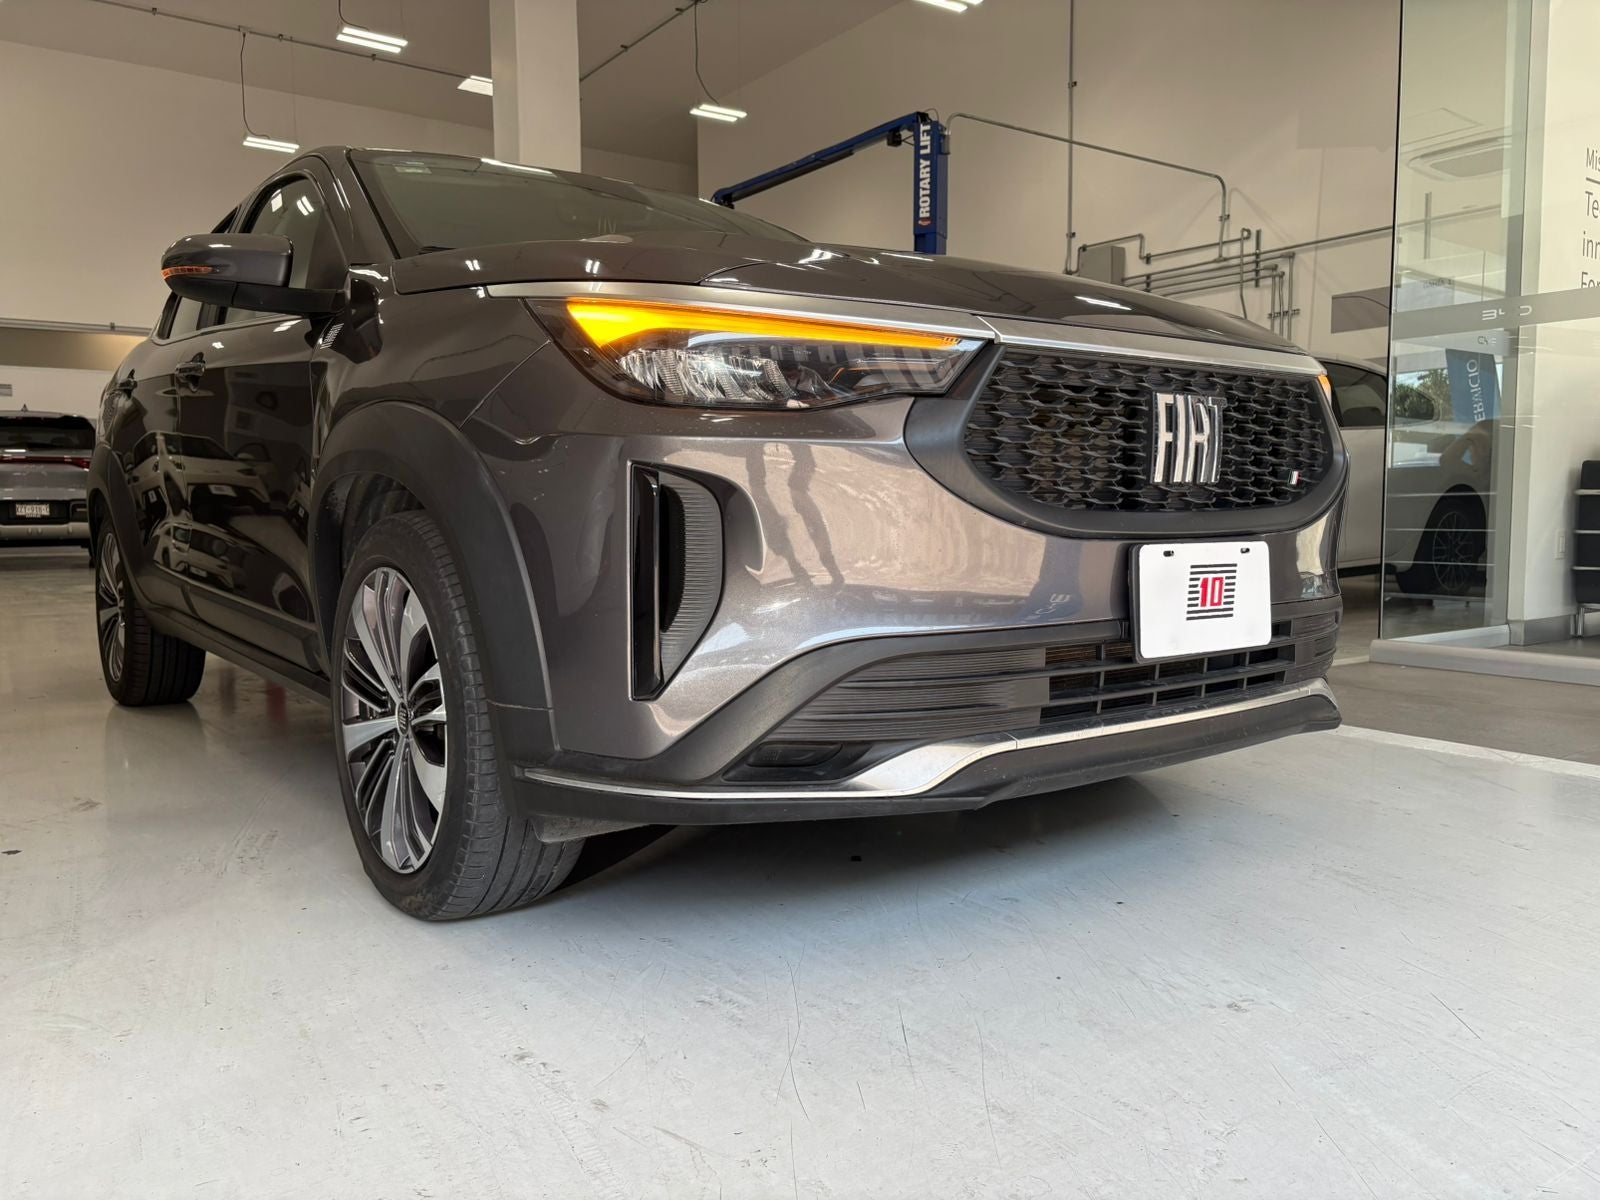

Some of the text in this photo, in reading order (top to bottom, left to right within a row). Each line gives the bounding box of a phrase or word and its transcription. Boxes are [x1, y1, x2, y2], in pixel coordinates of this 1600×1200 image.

[919, 123, 931, 218] ROTARY LIFT
[1585, 191, 1600, 219] Te
[1152, 392, 1226, 484] FIAT
[1199, 576, 1224, 608] 10
